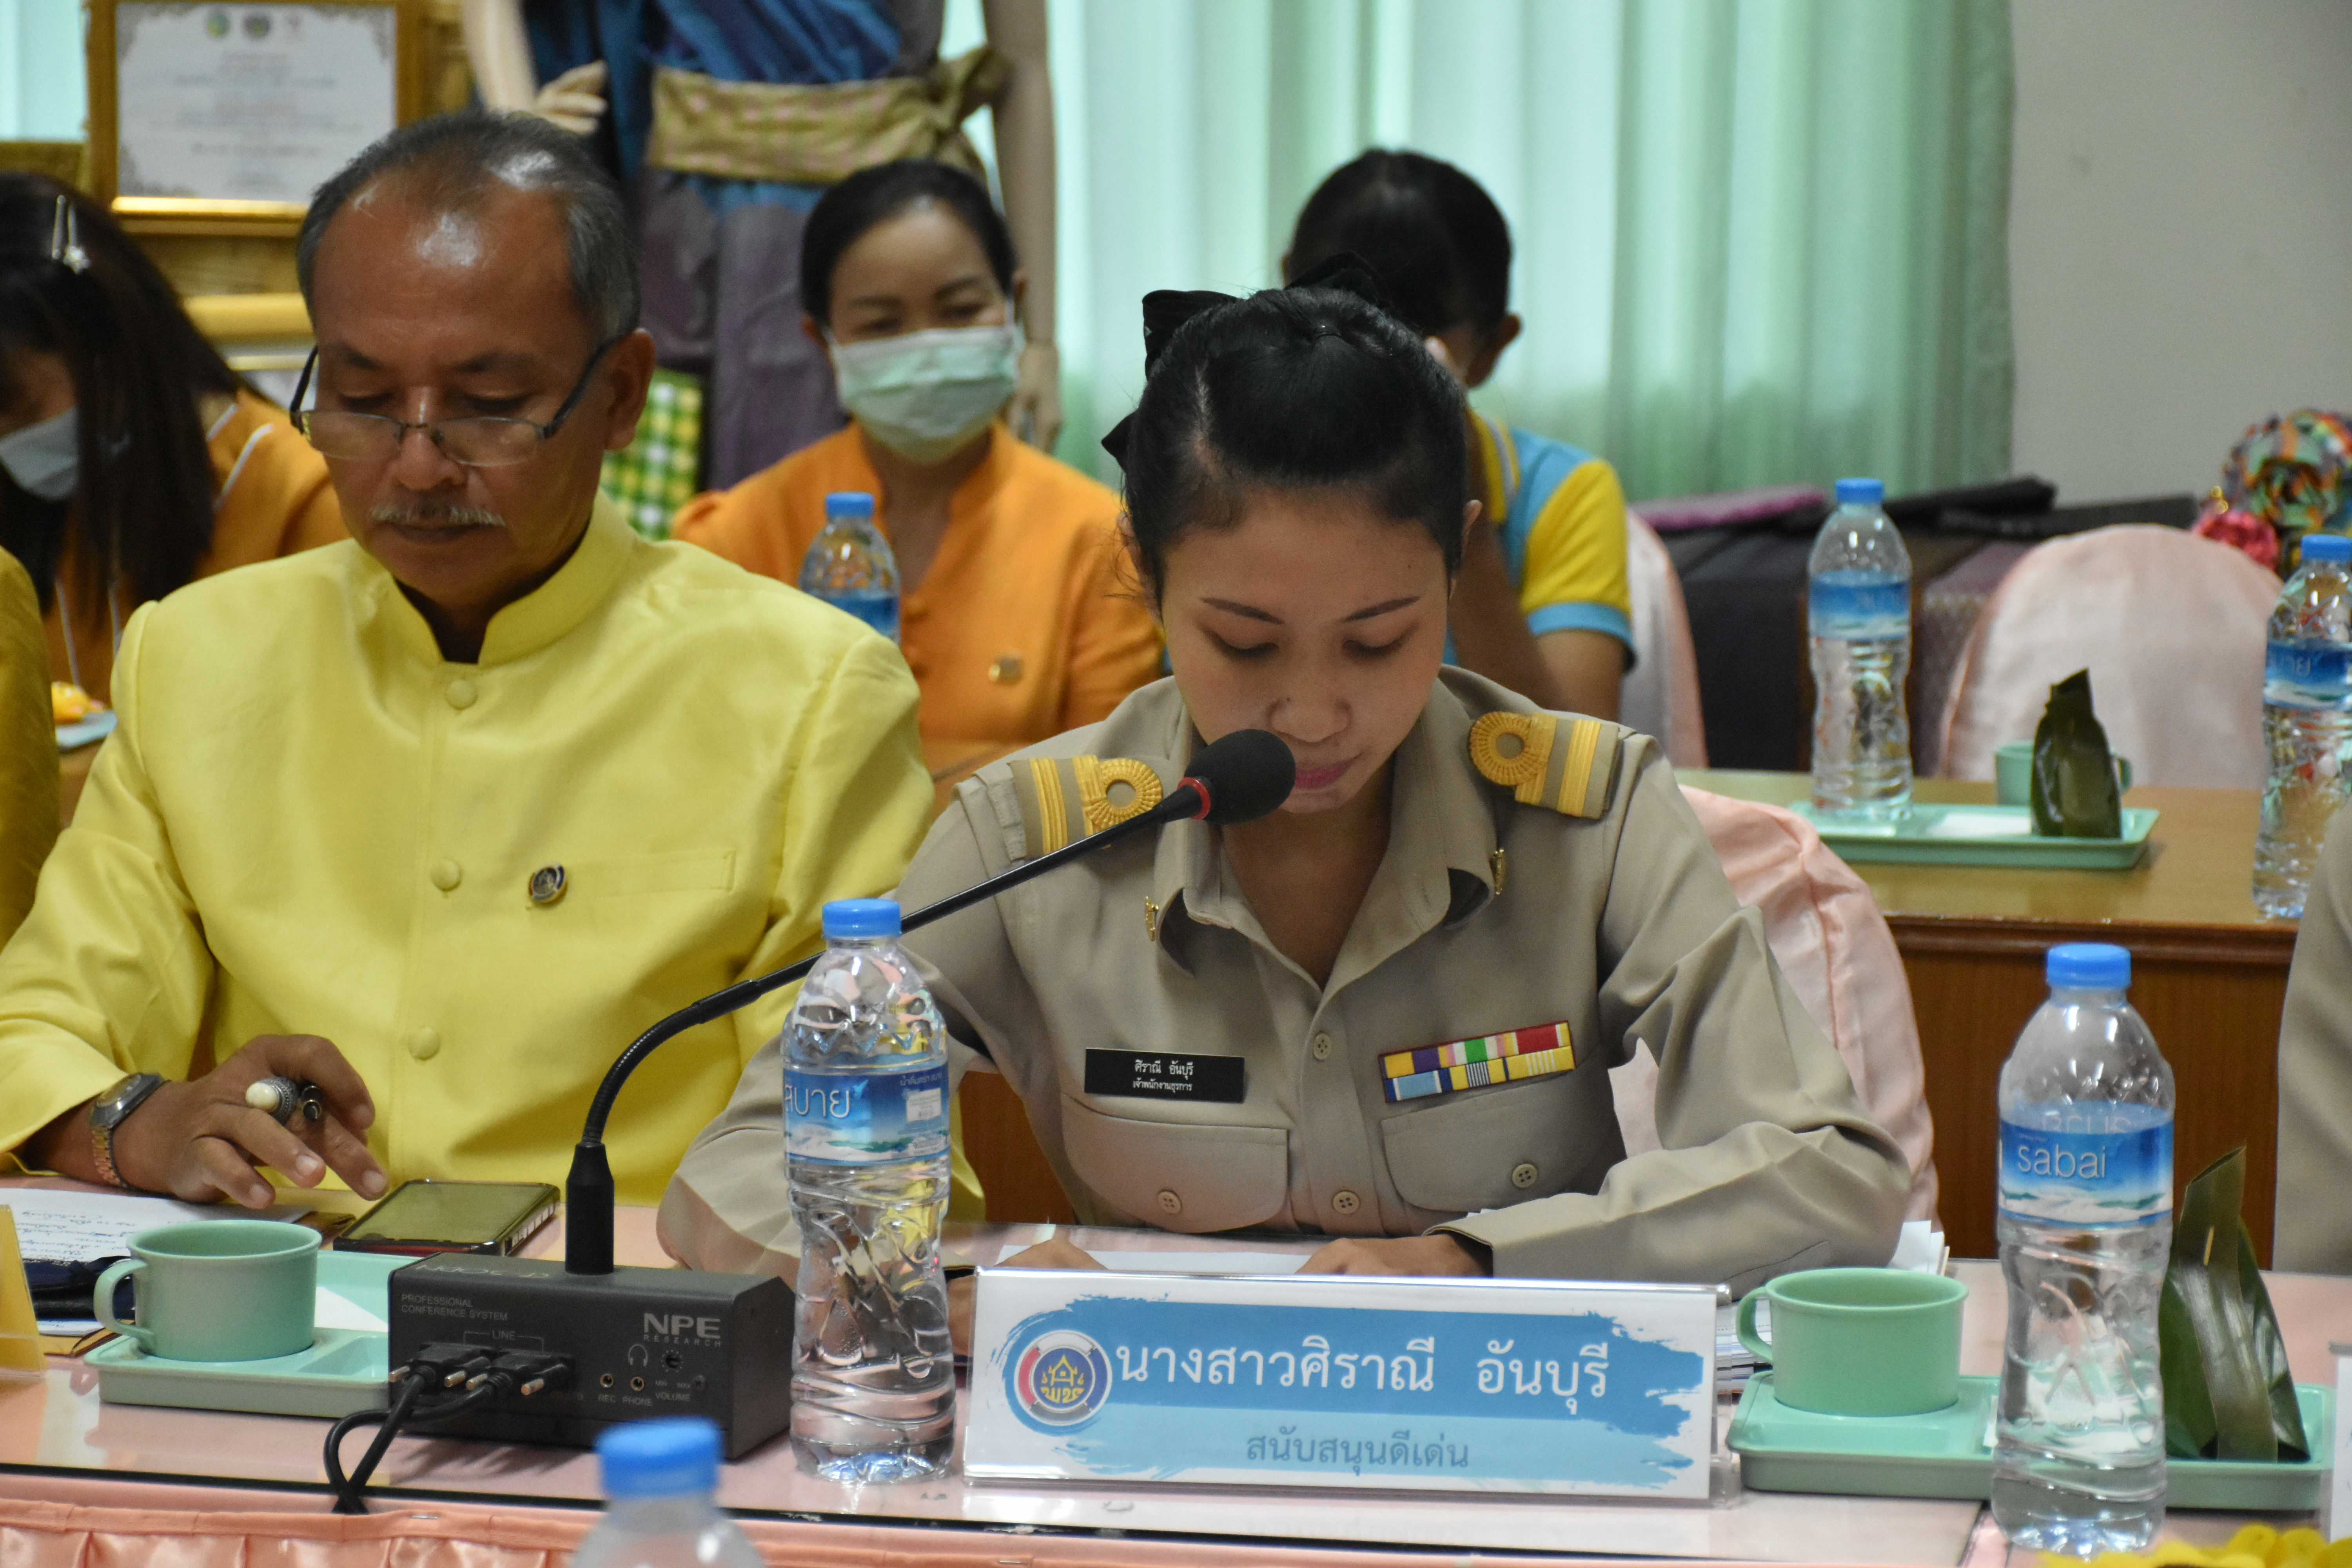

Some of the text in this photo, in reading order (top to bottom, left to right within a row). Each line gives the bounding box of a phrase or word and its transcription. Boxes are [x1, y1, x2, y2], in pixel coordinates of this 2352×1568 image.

[1135, 1059, 1194, 1080] ศิราณี อันบุรี
[785, 1084, 850, 1118] สบาย
[2018, 1144, 2106, 1178] sabai
[401, 1294, 473, 1308] PROFESSIONAL
[401, 1305, 508, 1321] CONFERENCE SYSTEM
[644, 1312, 720, 1339] NPE
[492, 1330, 516, 1341] LINE
[643, 1334, 721, 1347] RESEARCH
[1116, 1335, 1610, 1415] นางสาวศิราณี อันบุรี
[598, 1394, 616, 1403] REC
[622, 1396, 653, 1406] PHONE
[655, 1392, 690, 1402] VOLUME
[1247, 1426, 1469, 1475] สนับสนุนดีเด่น
